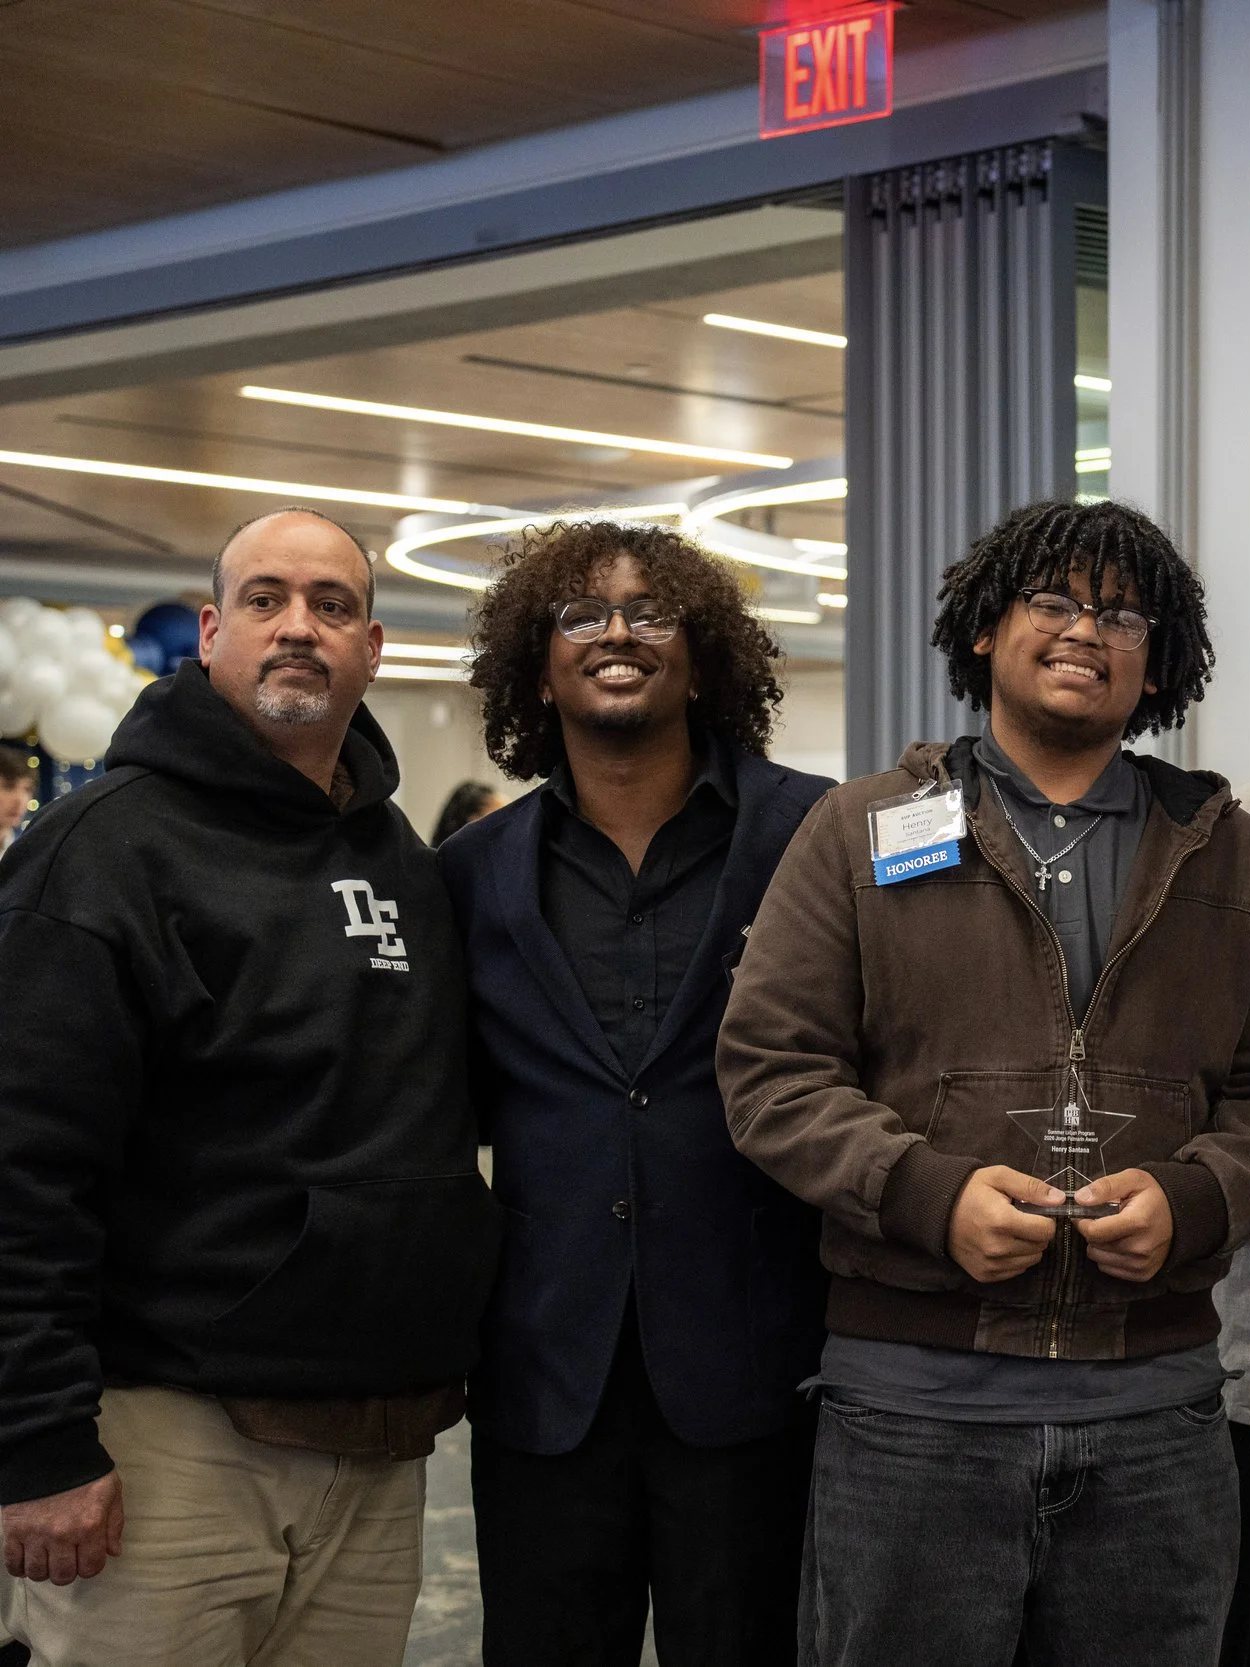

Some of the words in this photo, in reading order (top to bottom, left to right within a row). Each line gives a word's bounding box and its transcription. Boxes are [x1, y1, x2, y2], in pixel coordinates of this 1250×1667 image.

[784, 18, 872, 120] EXIT
[902, 818, 933, 831] Henry
[886, 850, 948, 877] HONOREE
[331, 879, 407, 957] DE
[370, 958, 392, 970] DEEP
[391, 961, 409, 972] END
[1051, 1146, 1067, 1154] Henry
[1068, 1146, 1090, 1154] Santana
